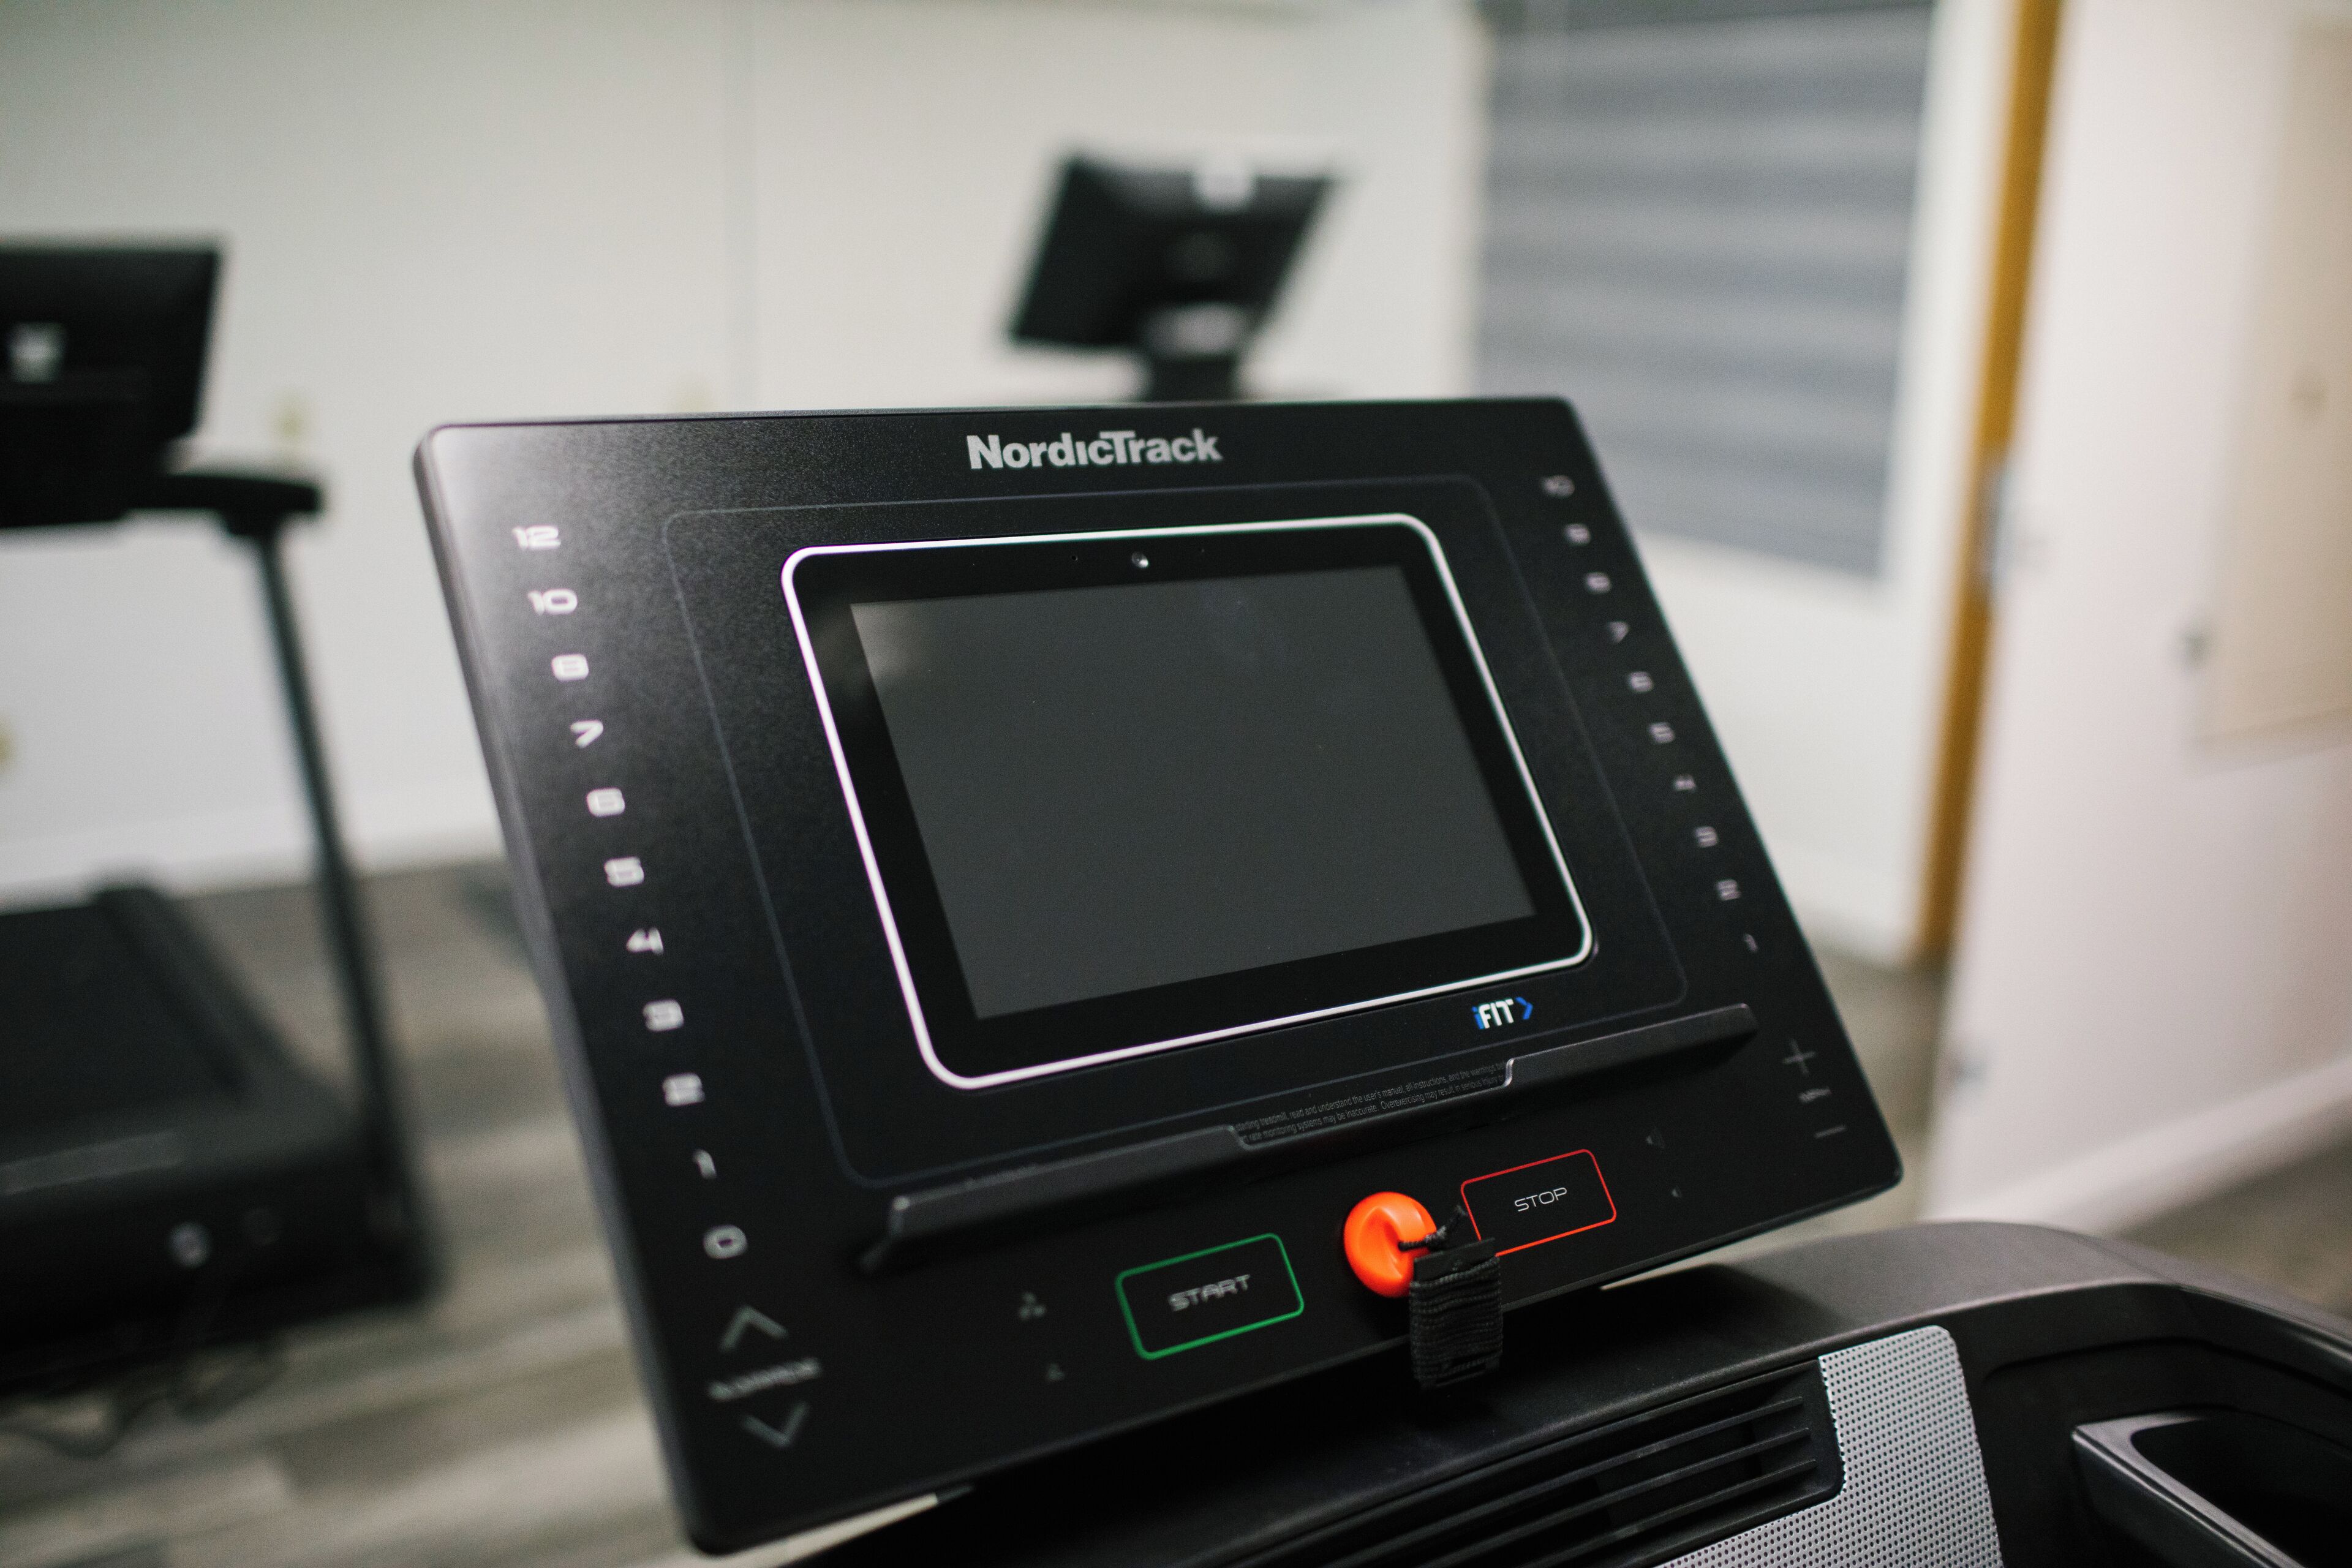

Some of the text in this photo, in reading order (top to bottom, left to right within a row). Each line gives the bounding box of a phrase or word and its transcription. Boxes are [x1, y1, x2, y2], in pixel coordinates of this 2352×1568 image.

[967, 428, 1223, 470] NordicTrack
[513, 526, 560, 549] 12
[528, 589, 577, 613] 10
[552, 654, 589, 680] 8
[571, 720, 603, 747] 7
[627, 929, 663, 952] 4
[1471, 998, 1515, 1030] iFIT
[1289, 1107, 1304, 1119] read
[1305, 1104, 1317, 1115] and
[1318, 1097, 1352, 1111] understand
[1352, 1093, 1363, 1104] the
[1363, 1089, 1381, 1101] user's
[1382, 1085, 1405, 1097] manual,
[1448, 1072, 1460, 1082] and
[1297, 1118, 1322, 1131] systems
[1322, 1114, 1336, 1126] may
[1336, 1110, 1345, 1120] be
[1381, 1093, 1425, 1110] Overexercising
[1425, 1090, 1437, 1101] may
[1438, 1085, 1454, 1096] result
[695, 1151, 715, 1176] 1
[1515, 1187, 1567, 1212] STOP
[1168, 1273, 1250, 1312] START
